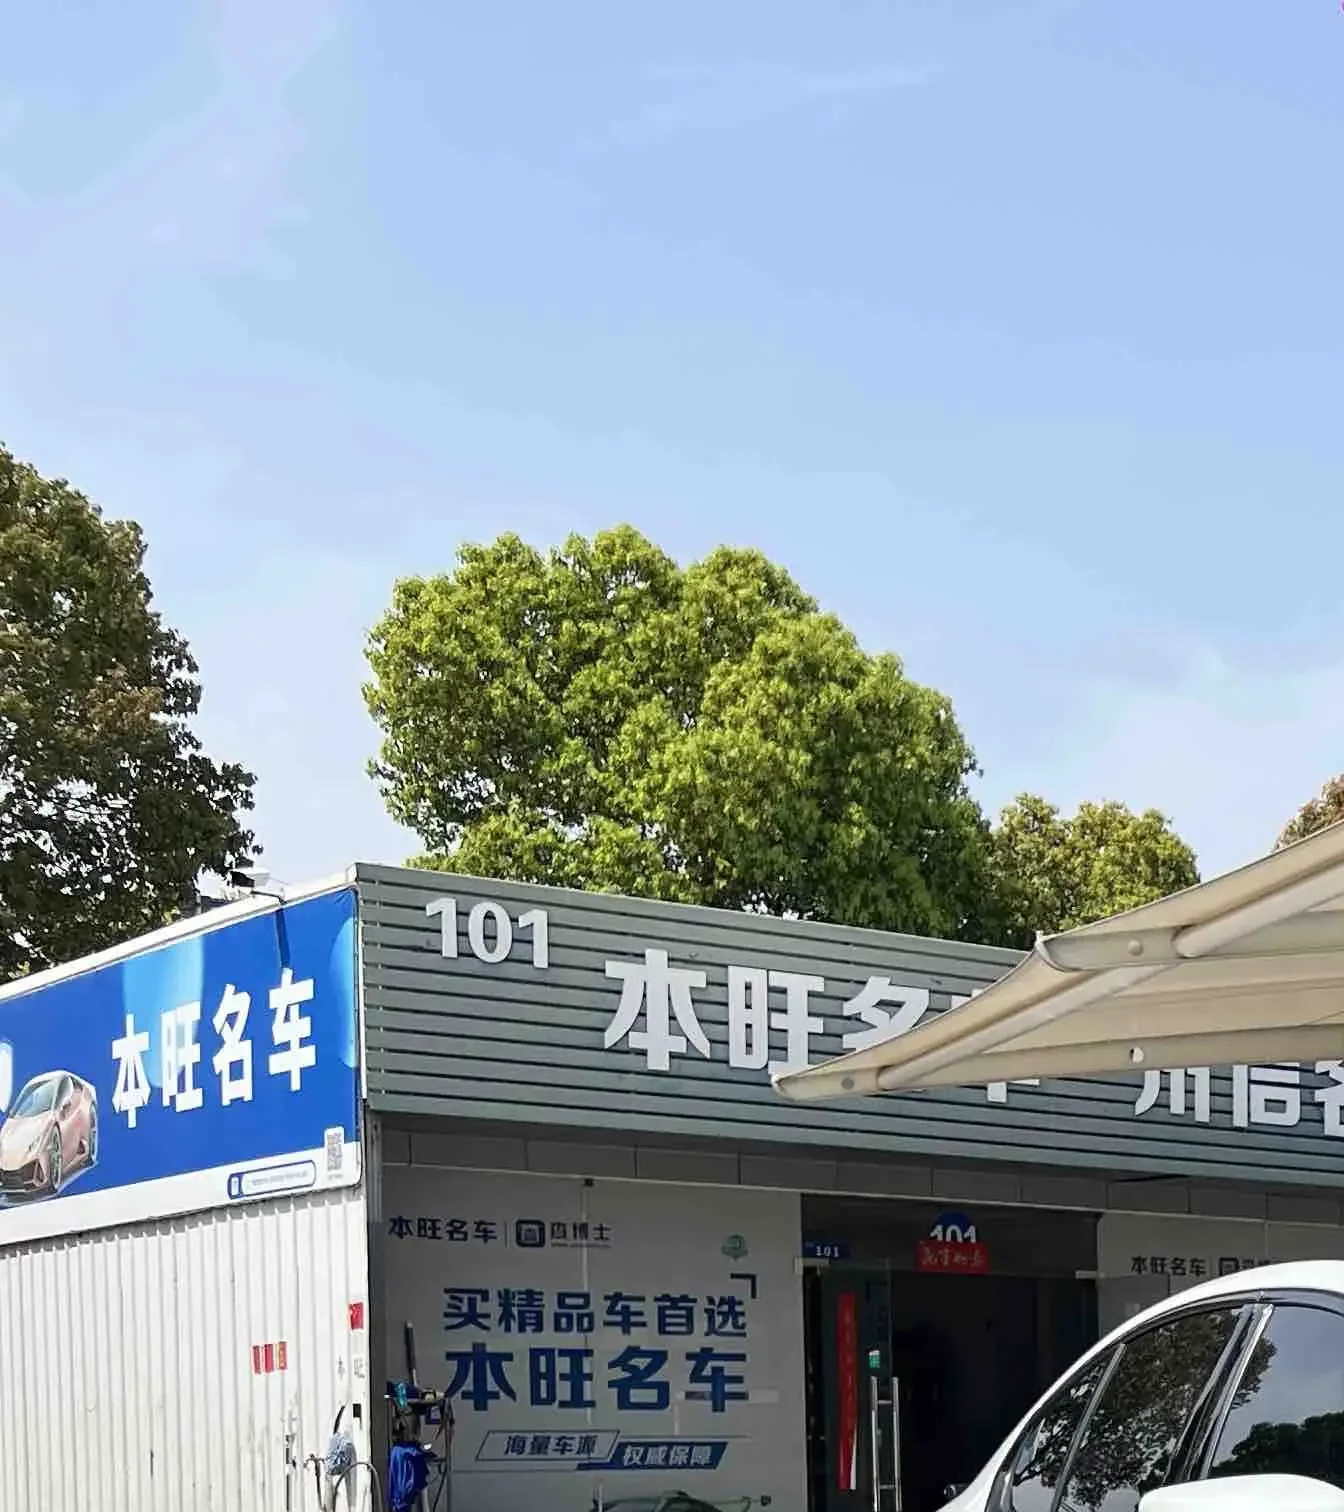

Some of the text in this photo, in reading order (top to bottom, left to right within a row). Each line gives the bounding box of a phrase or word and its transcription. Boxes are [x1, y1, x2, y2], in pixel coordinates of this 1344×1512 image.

[426, 897, 549, 969] 101
[604, 949, 1040, 1103] 本旺名
[112, 967, 317, 1129] 本旺名车
[388, 1216, 498, 1243] 本旺名车
[816, 1245, 840, 1258] 101
[1131, 1256, 1207, 1277] 本旺名车
[443, 1287, 748, 1338] 买精品车首选
[443, 1341, 750, 1413] 本旺名车
[504, 1435, 599, 1456] 海量车源
[622, 1445, 712, 1467] 权威保障
